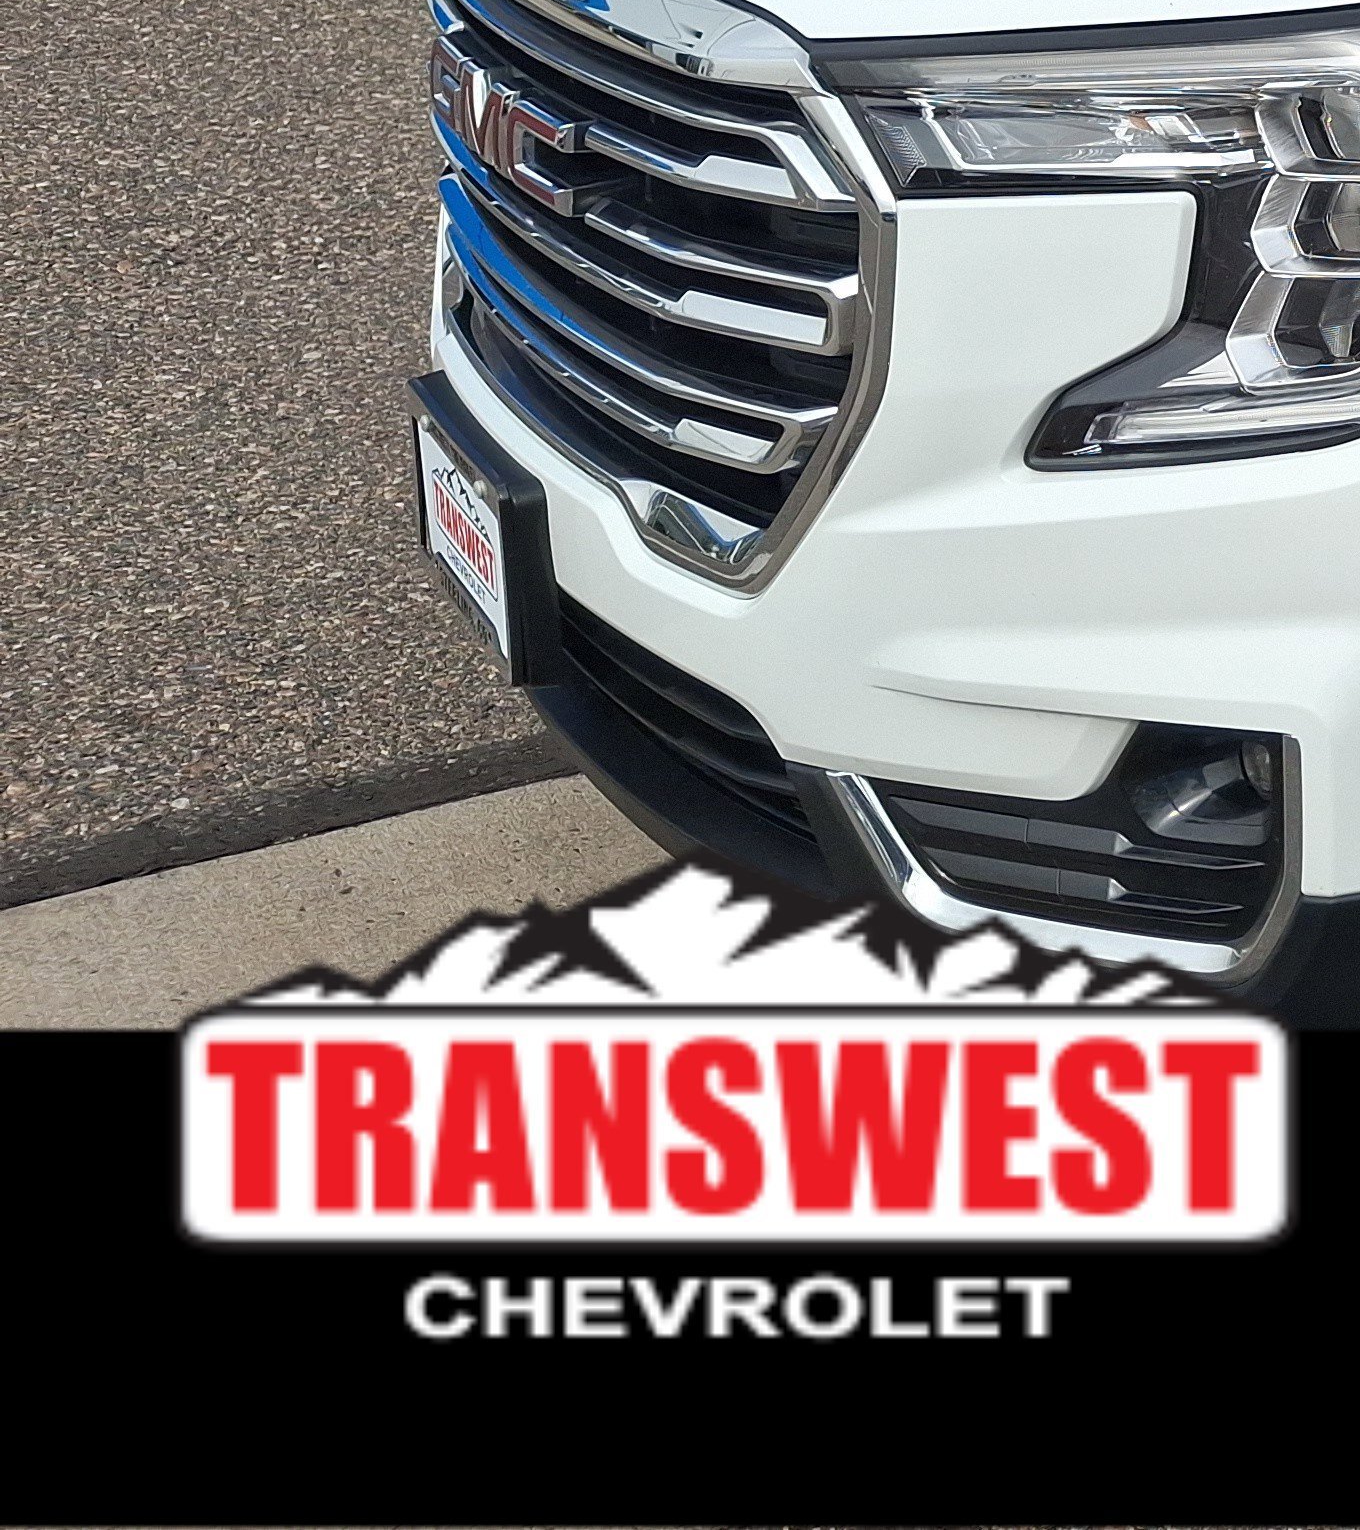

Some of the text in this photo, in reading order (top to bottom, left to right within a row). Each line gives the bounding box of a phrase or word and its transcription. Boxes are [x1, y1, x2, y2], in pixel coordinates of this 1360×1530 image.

[430, 35, 575, 217] GMC
[433, 481, 495, 591] TRANSWEST
[446, 544, 486, 606] CHEVROLET
